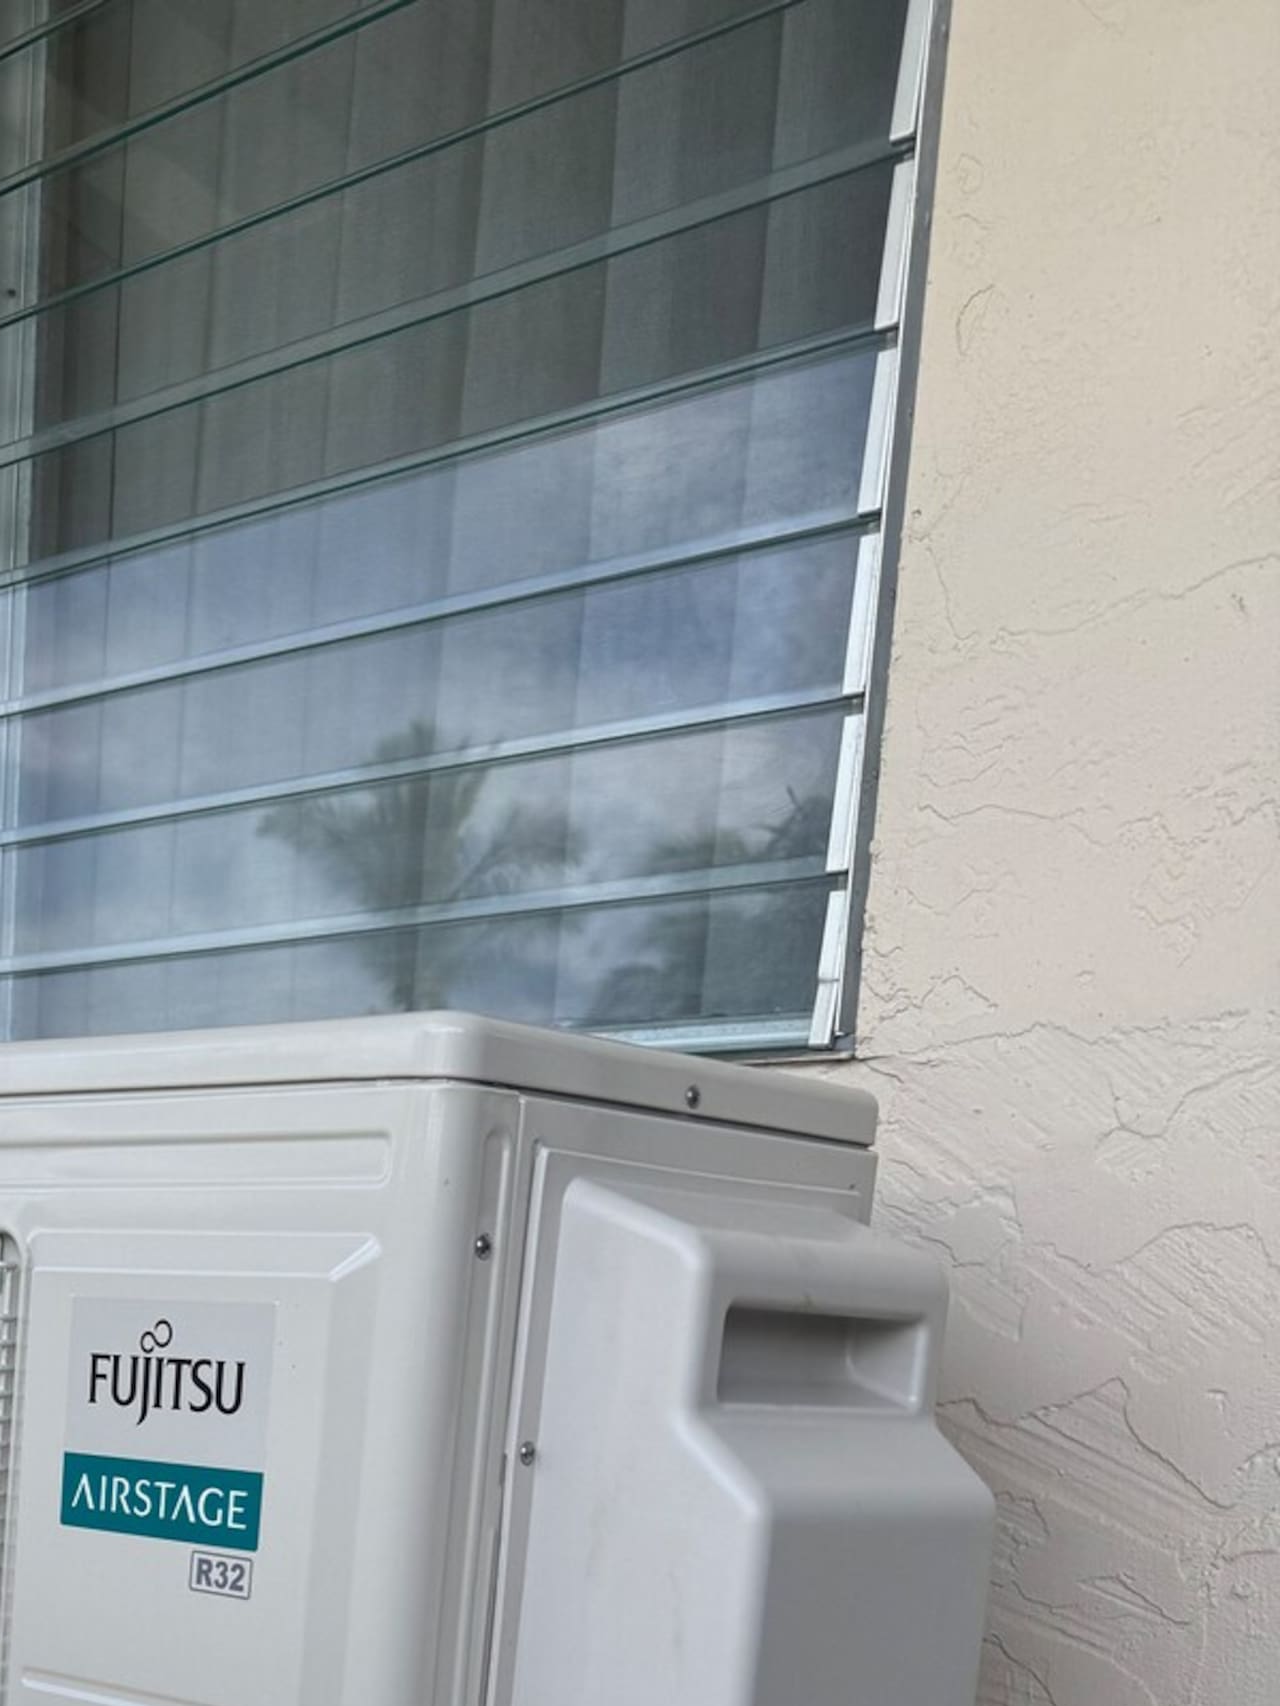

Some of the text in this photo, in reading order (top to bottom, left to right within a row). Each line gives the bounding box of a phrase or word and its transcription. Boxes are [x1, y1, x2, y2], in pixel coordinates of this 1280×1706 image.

[87, 1352, 247, 1426] FUJITSU
[71, 1472, 249, 1530] AIRSTAGE
[195, 1557, 246, 1593] R32
